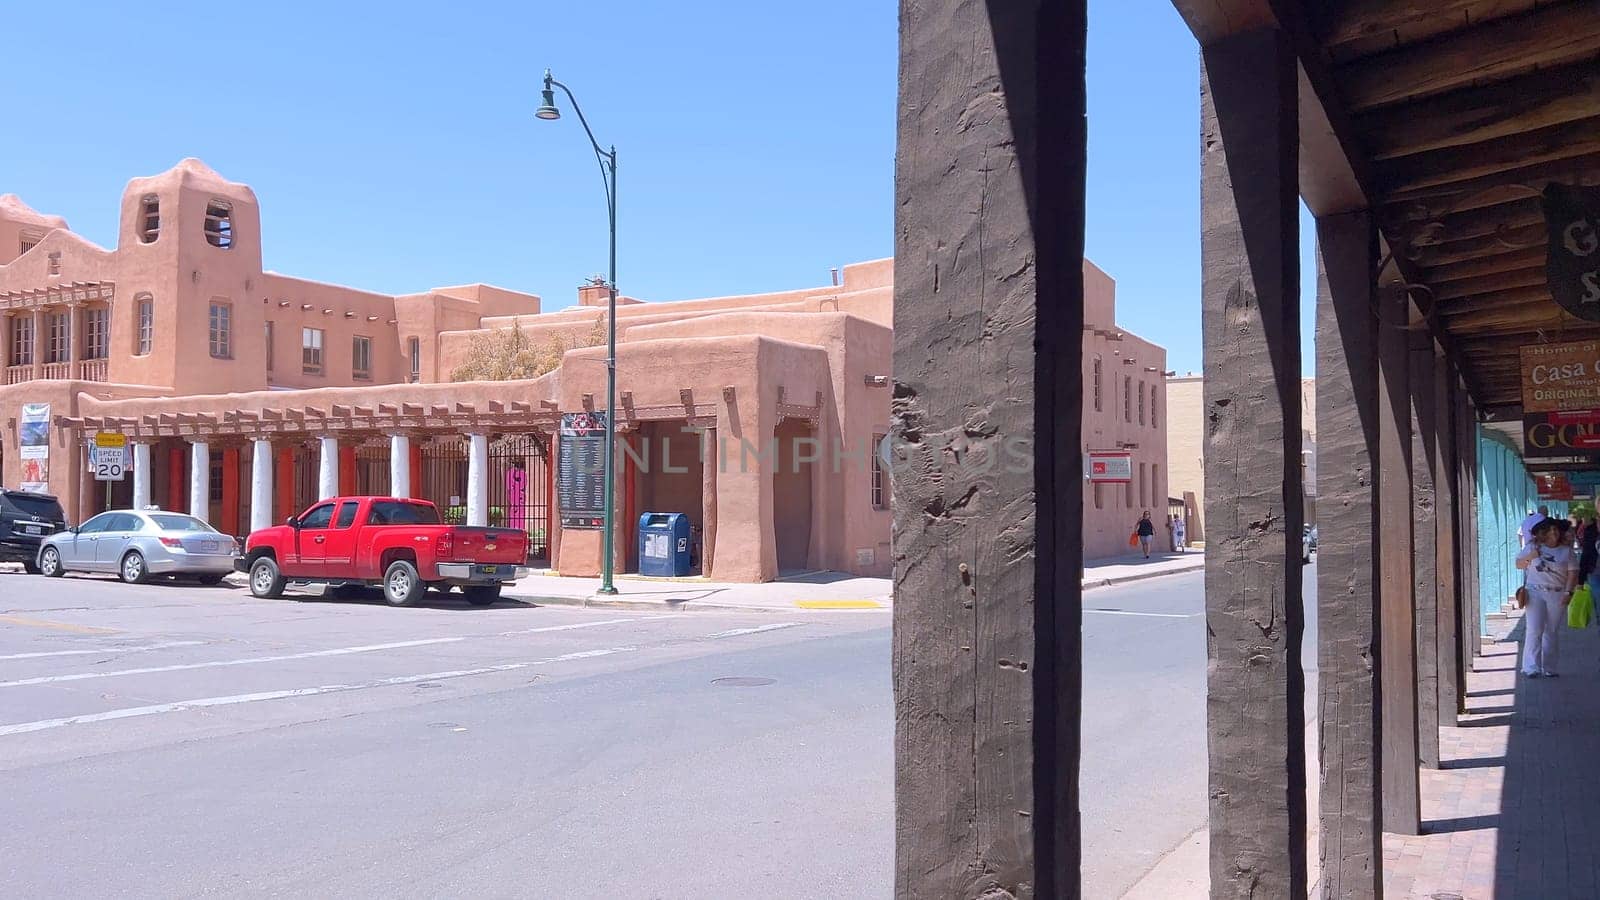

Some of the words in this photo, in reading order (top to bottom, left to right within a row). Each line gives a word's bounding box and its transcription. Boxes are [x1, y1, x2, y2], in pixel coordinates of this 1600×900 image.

[1532, 362, 1586, 385] Casa
[1534, 388, 1592, 401] ORIGINAL
[98, 464, 121, 476] 20
